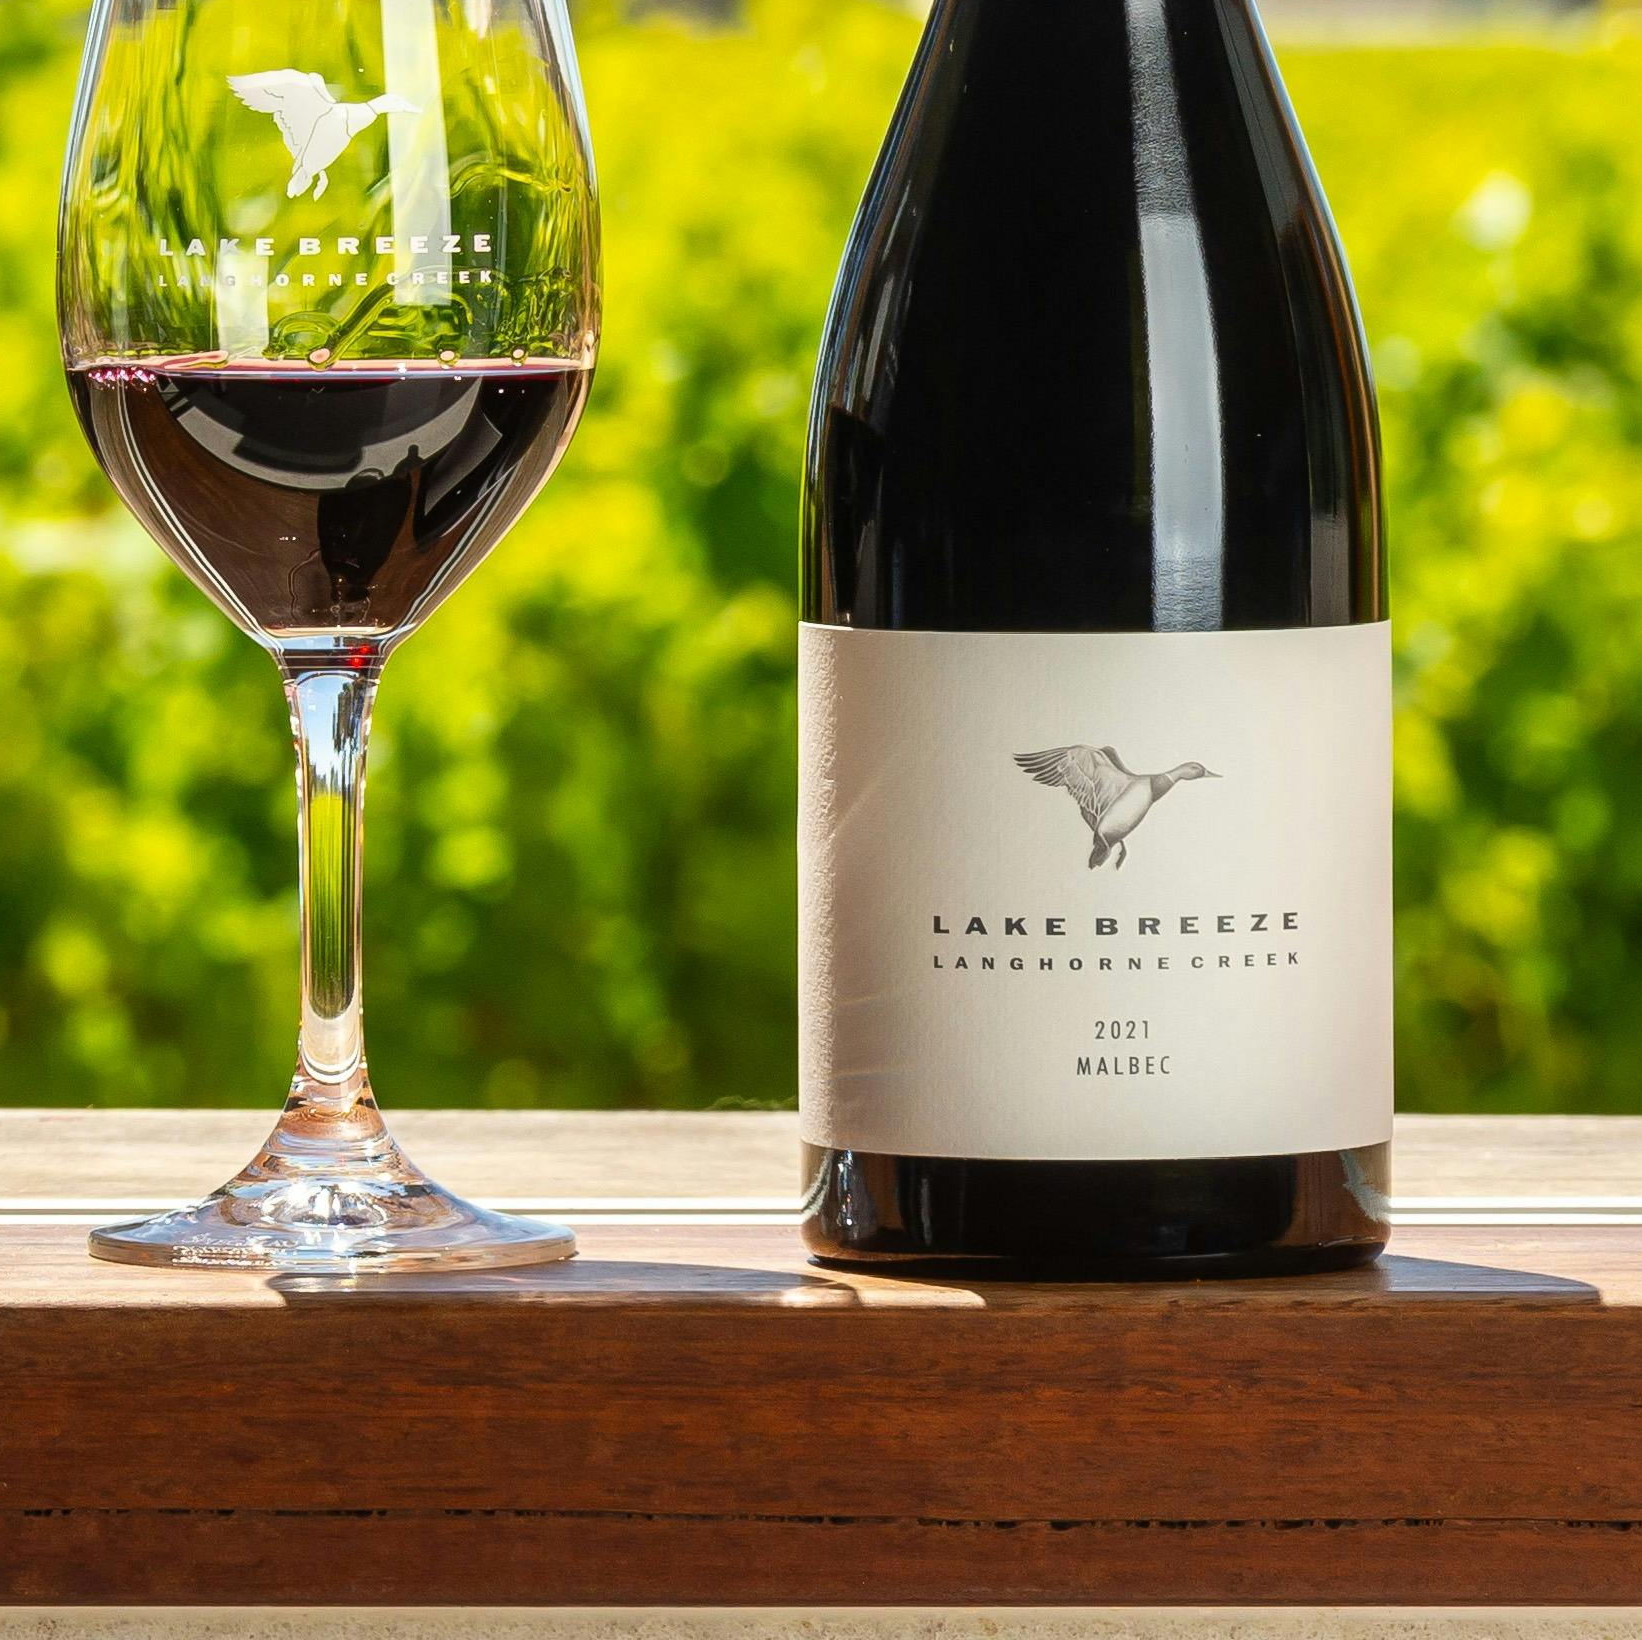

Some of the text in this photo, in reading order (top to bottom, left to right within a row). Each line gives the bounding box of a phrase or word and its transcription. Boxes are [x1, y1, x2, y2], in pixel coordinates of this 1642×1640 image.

[159, 234, 492, 257] LAKE BREEZE
[158, 270, 492, 288] LANGHORNE CREEK
[933, 912, 1299, 936] LAKE BREEZE
[933, 952, 1299, 971] LANGHORNE CREEK
[1095, 1020, 1150, 1040] 2021
[1076, 1056, 1171, 1076] MALBEC
